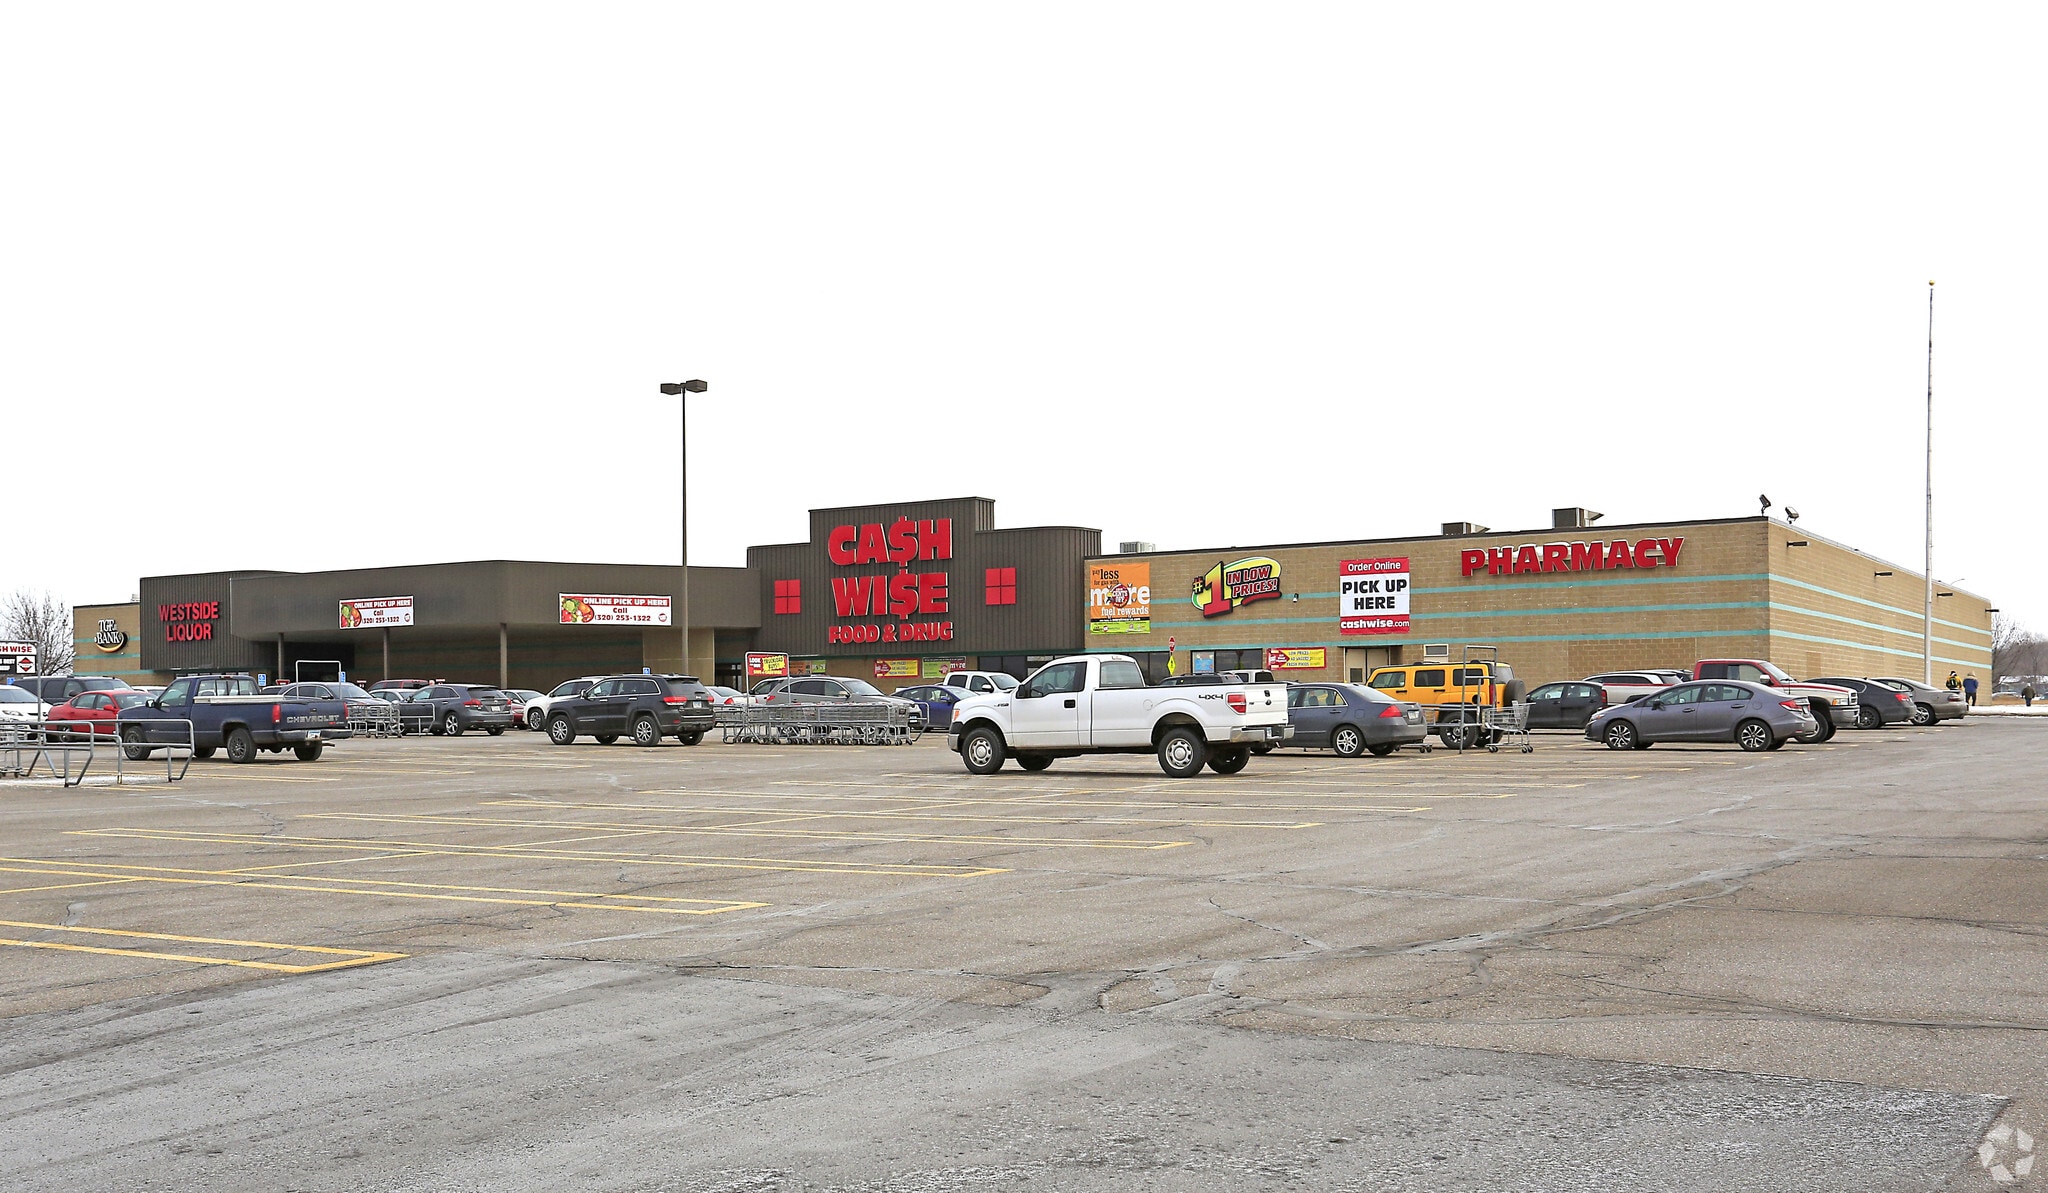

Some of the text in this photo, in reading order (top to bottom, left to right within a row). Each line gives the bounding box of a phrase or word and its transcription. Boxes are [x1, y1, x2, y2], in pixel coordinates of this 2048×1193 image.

[1462, 537, 1684, 576] PHARMACY
[1348, 561, 1401, 572] Order Online
[1100, 569, 1119, 580] less
[1227, 566, 1271, 584] IN LOW
[1232, 579, 1278, 598] PRICES!
[1342, 579, 1407, 594] PICK UP
[1354, 596, 1395, 610] HERE
[158, 601, 219, 621] WESTSIDE
[1101, 606, 1149, 616] fuel rewards
[1340, 619, 1410, 629] cashwise.com
[96, 632, 120, 645] BANK
[166, 623, 211, 642] LIQUOR
[829, 622, 953, 644] FOOD & DRUG
[286, 714, 340, 724] CHEVROLET
